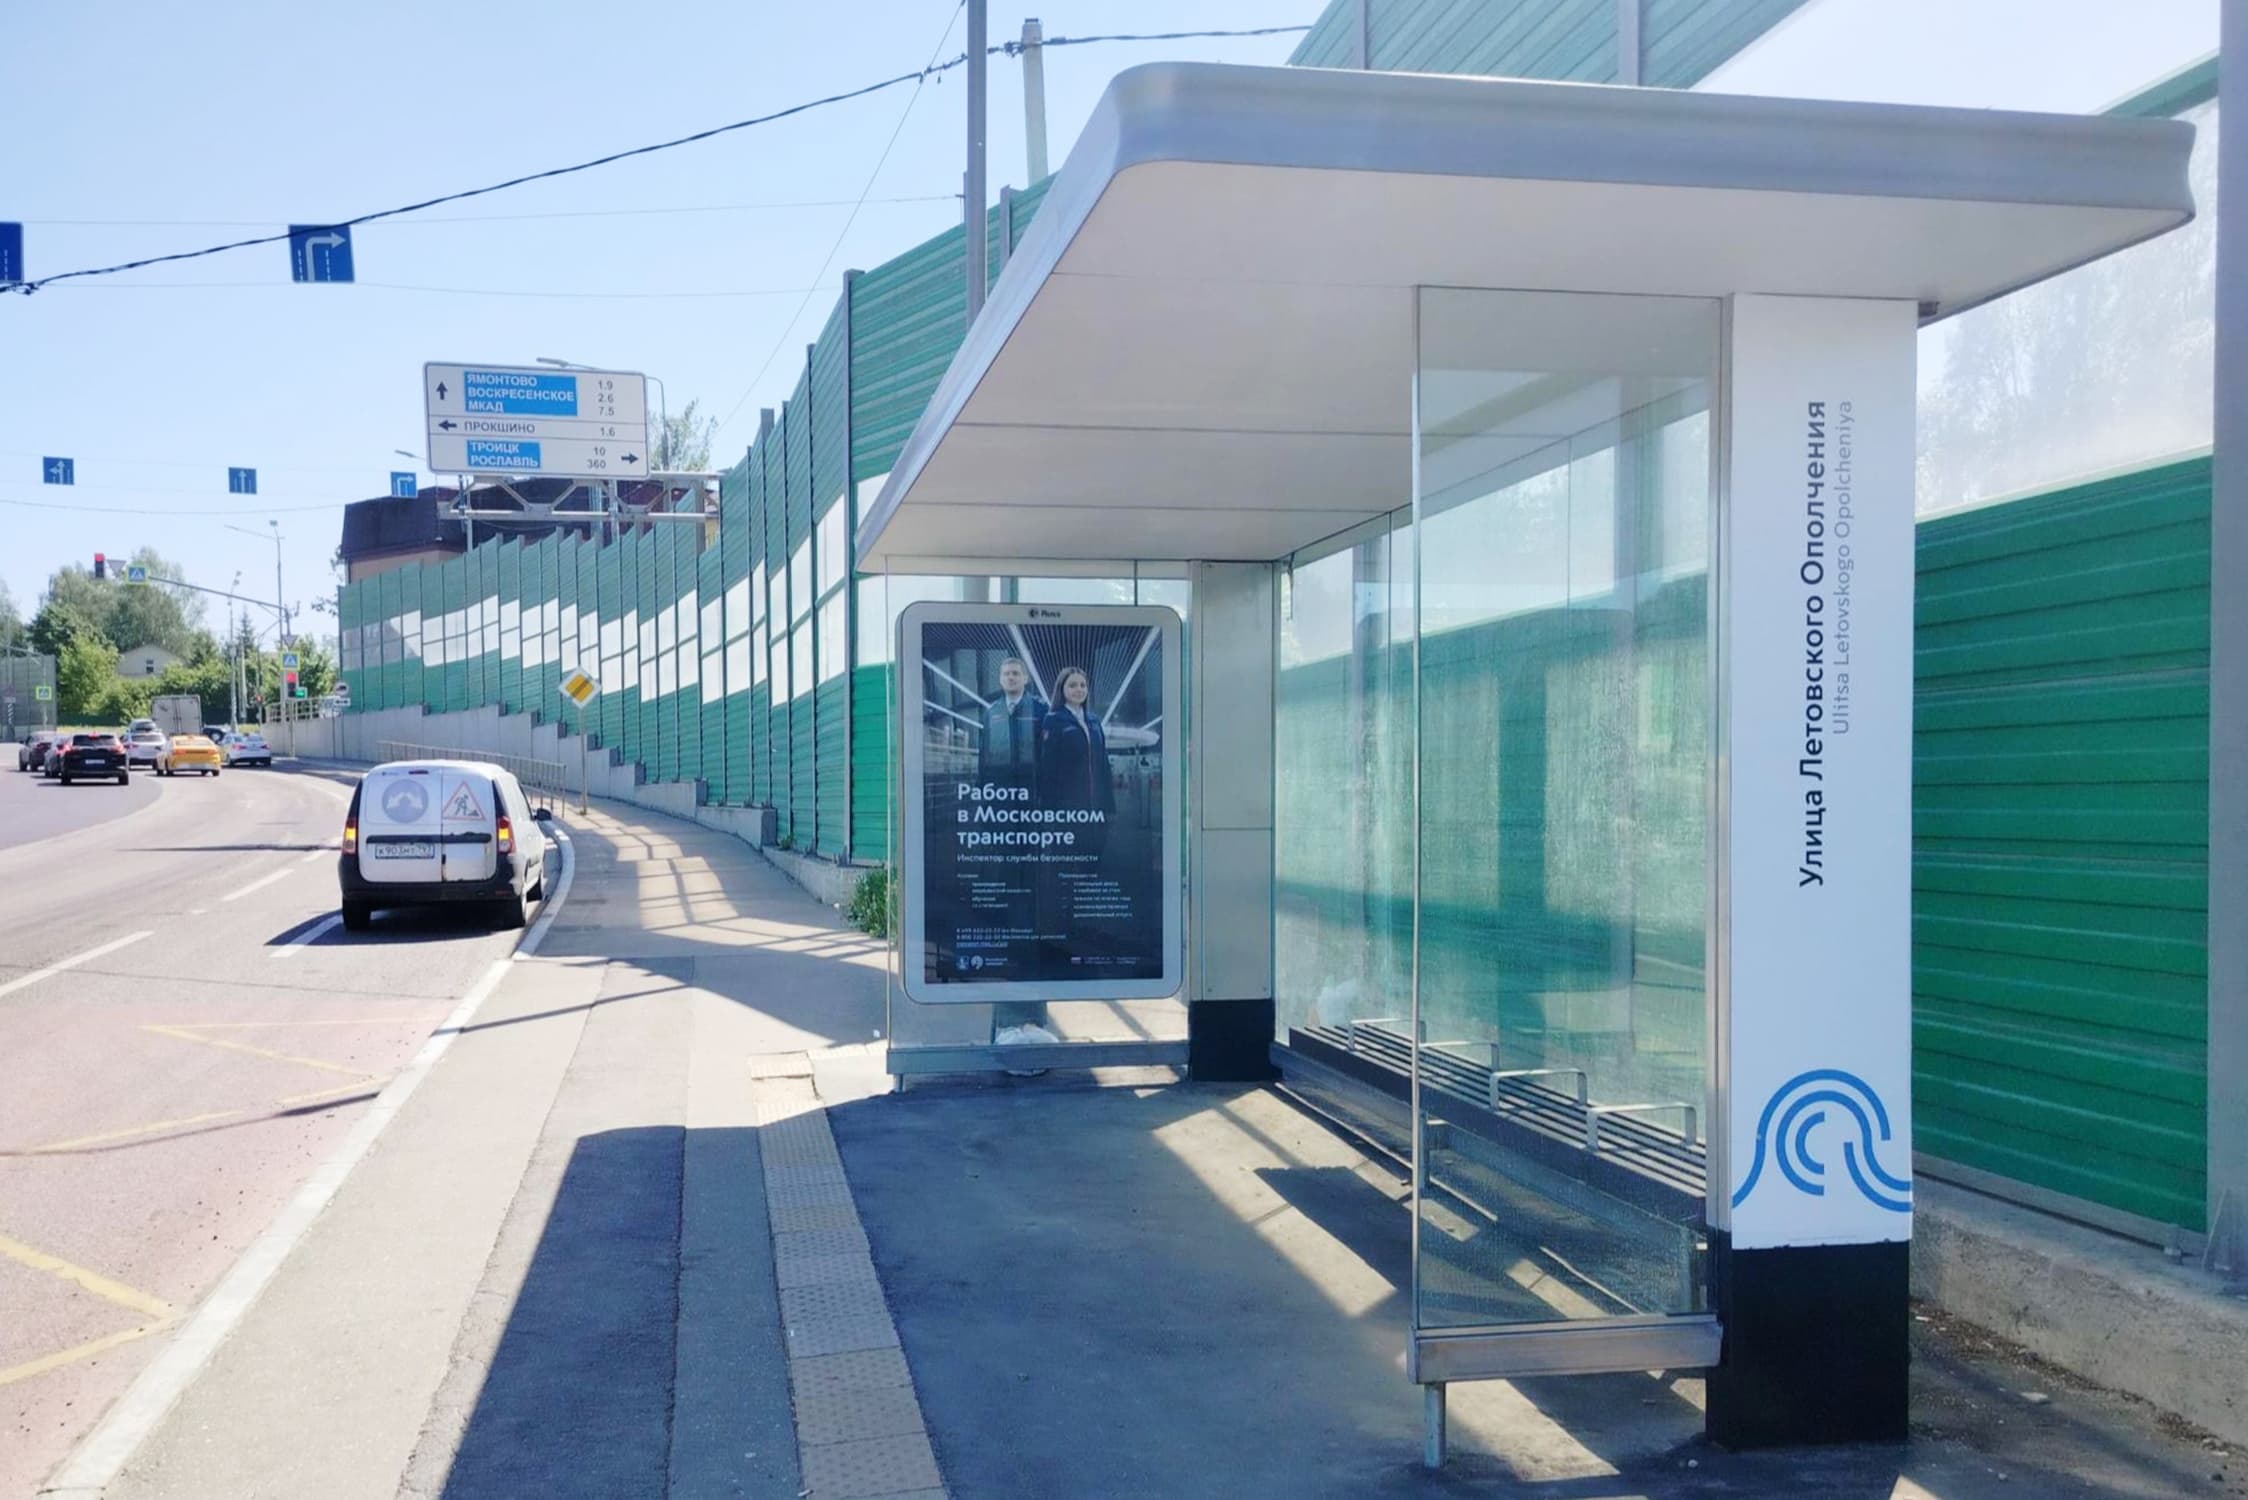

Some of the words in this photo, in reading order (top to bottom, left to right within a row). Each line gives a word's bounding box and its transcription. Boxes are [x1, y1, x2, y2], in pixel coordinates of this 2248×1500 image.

[466, 373, 538, 387] ЯМОНТОВО
[598, 380, 613, 391] 1.9
[467, 386, 575, 402] ВОСКРЕСЕНСКОЕ
[598, 393, 614, 404] 2.6
[468, 401, 504, 413] МКАД
[599, 406, 615, 417] 7.5
[464, 420, 535, 434] ПРОКШИНО
[600, 426, 616, 437] 1.6
[470, 442, 520, 455] ТРОИЦК
[594, 446, 606, 457] 10
[470, 454, 539, 468] РОСЛАВЛЬ
[586, 458, 607, 469] 360
[1834, 401, 1855, 539] Opolcheniya
[1800, 402, 1825, 585] Ополчения
[1833, 545, 1854, 665] Letovskogo
[1799, 595, 1824, 781] Летовского
[1832, 673, 1850, 735] Ulitsa
[957, 782, 1029, 801] Работа
[957, 809, 969, 823] в
[974, 806, 1105, 823] Московском
[957, 830, 1075, 848] транспорте
[1799, 790, 1826, 888] Улица
[957, 853, 1004, 863] Инспектор
[1006, 853, 1039, 863] службы
[1040, 853, 1099, 863] безопасности
